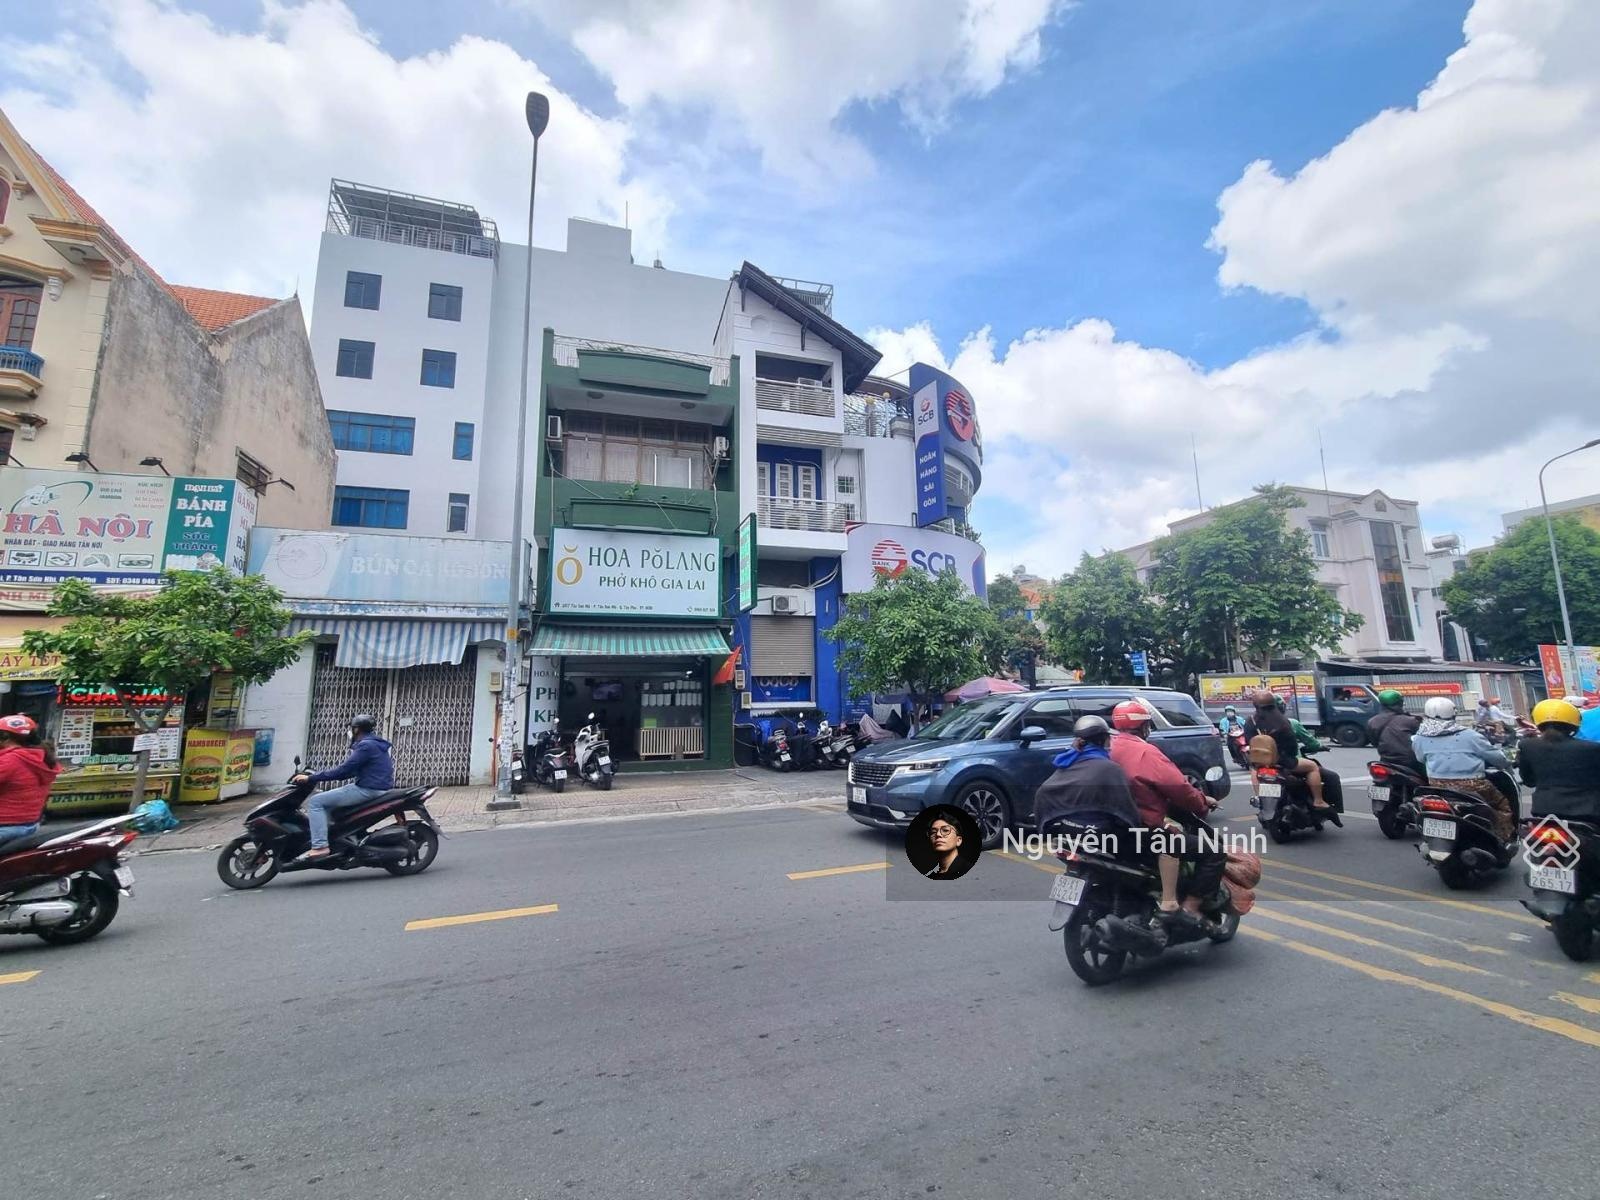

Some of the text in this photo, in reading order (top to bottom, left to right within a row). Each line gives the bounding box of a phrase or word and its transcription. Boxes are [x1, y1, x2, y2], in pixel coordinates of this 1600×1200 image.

[918, 409, 935, 426] SCB
[919, 450, 937, 465] NGÂN
[919, 466, 938, 480] HÀNG
[923, 481, 936, 493] SÀI
[176, 495, 228, 512] BÁNH
[923, 497, 937, 508] GÒN
[2, 509, 153, 543] HÀ NỘI
[183, 512, 215, 528] PÍA
[42, 539, 58, 547] GIAO
[588, 546, 631, 568] HOA
[599, 572, 705, 591] PHỞ KHÔ GIA LAI
[535, 687, 558, 700] PH
[187, 739, 226, 748] HAMBURGER
